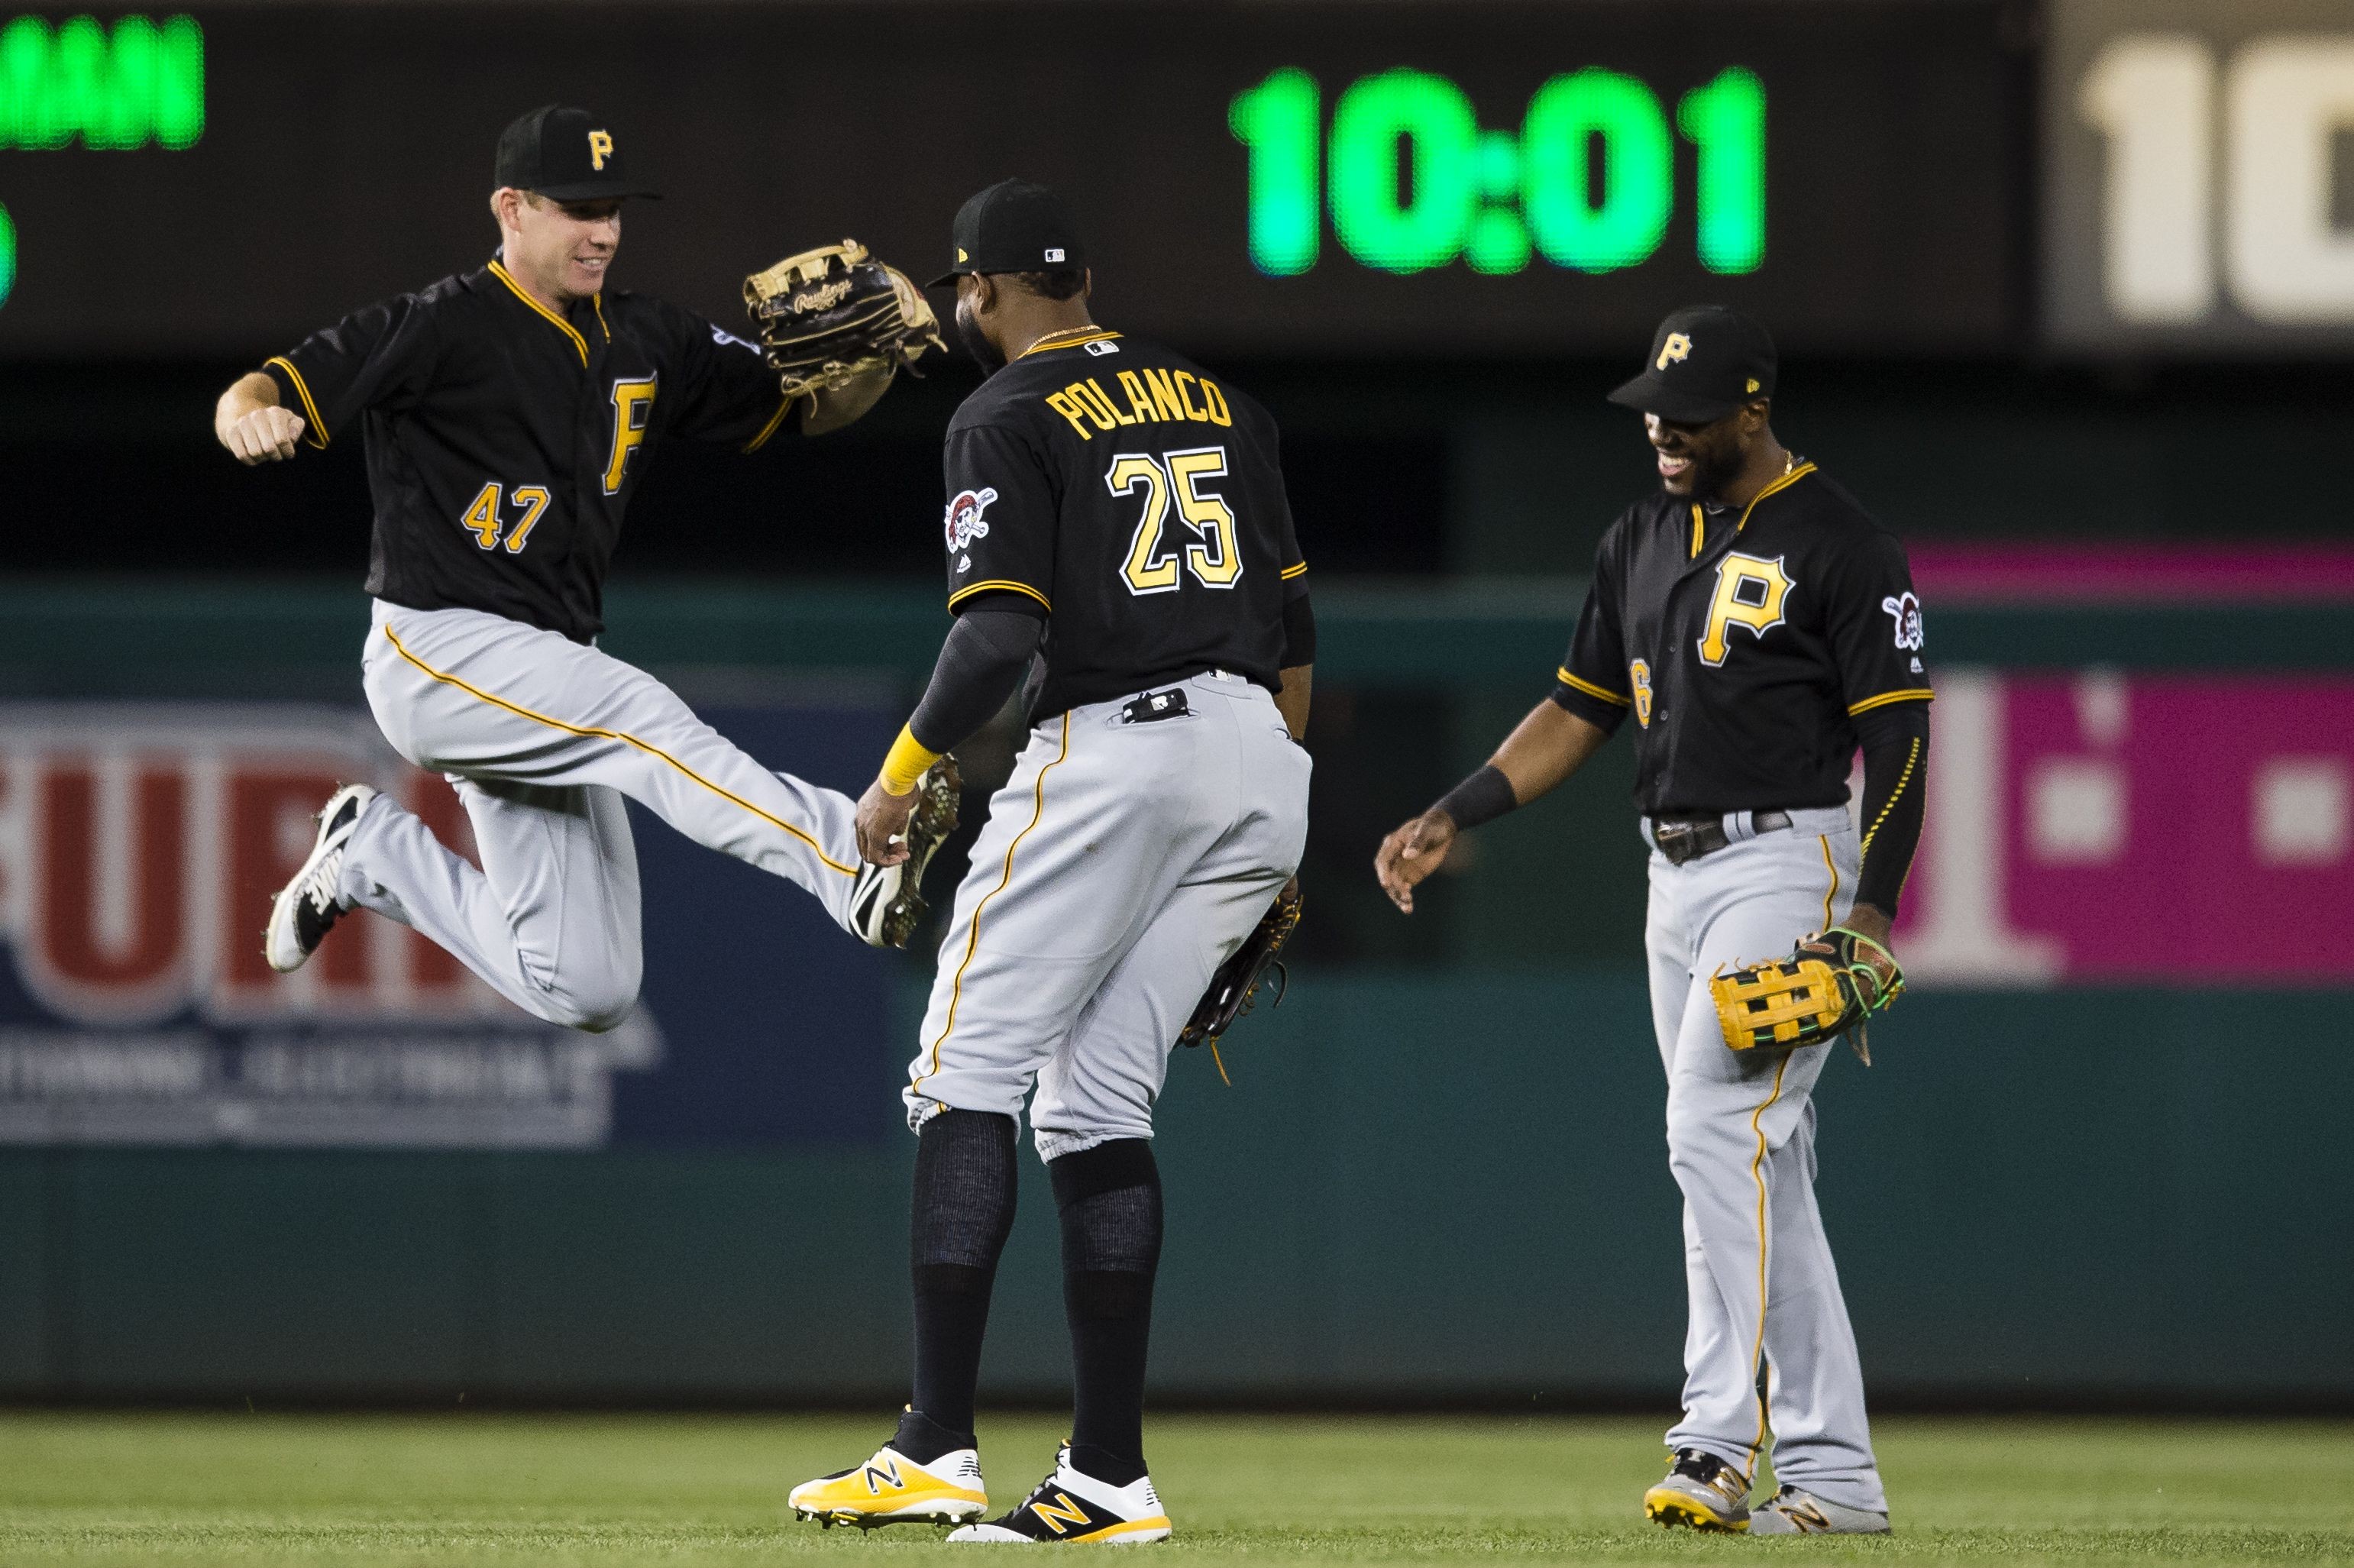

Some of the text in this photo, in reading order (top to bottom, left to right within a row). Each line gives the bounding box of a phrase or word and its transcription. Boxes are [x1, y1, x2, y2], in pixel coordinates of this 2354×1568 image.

[588, 129, 613, 171] P
[1229, 66, 1767, 276] 10:01
[1656, 331, 1693, 371] P
[1046, 369, 1232, 440] POLANCO
[461, 482, 551, 554] 47
[1104, 446, 1243, 596] 25
[1696, 551, 1796, 668] P
[1630, 658, 1653, 729] 6
